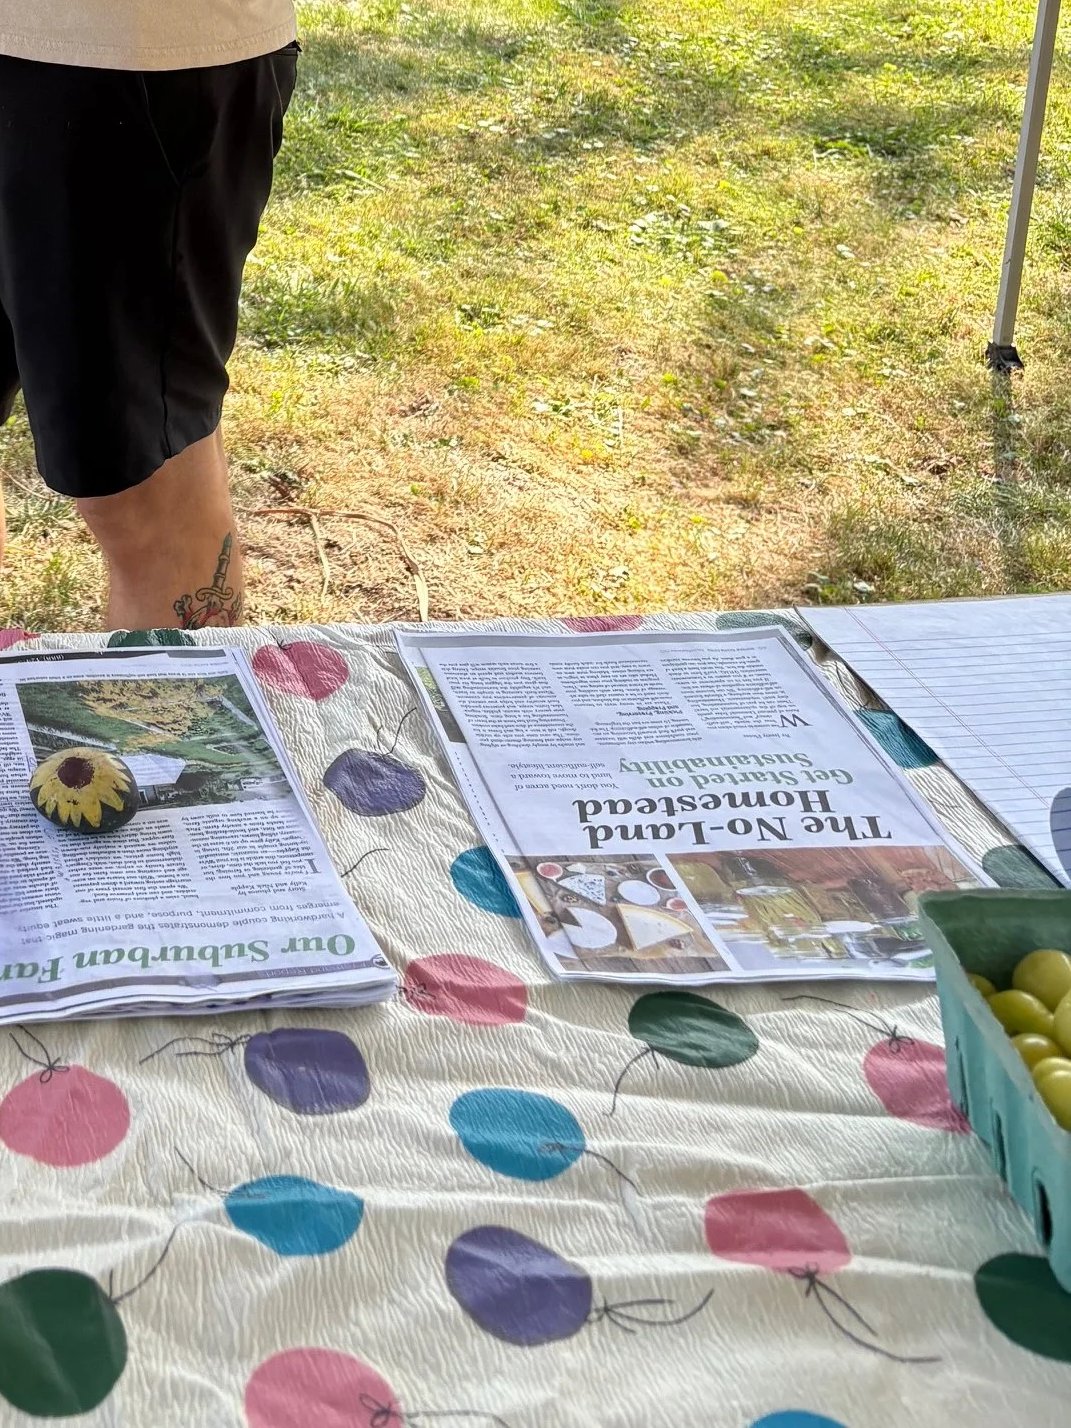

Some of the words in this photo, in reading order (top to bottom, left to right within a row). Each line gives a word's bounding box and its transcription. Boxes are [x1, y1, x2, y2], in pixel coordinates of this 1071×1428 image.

[507, 762, 544, 771] lifestyle.
[618, 753, 814, 777] Sustainability
[647, 776, 685, 789] on
[689, 771, 800, 791] Started
[801, 769, 855, 785] Get
[572, 790, 836, 823] Homestead
[582, 817, 793, 849] No-Land
[800, 815, 893, 840] The
[269, 905, 293, 913] from
[297, 901, 340, 910] emerges
[125, 913, 144, 923] and
[148, 909, 192, 919] purpose,
[196, 906, 266, 918] commitment,
[337, 912, 345, 921] A
[52, 918, 83, 930] sweat
[87, 916, 111, 925] little
[233, 917, 267, 928] couple
[270, 913, 334, 925] hardworking
[81, 923, 134, 936] gardening
[138, 924, 155, 933] the
[158, 920, 229, 931] demonstrates
[46, 930, 78, 942] magic
[281, 934, 356, 956] Our
[73, 939, 270, 970] Suburban
